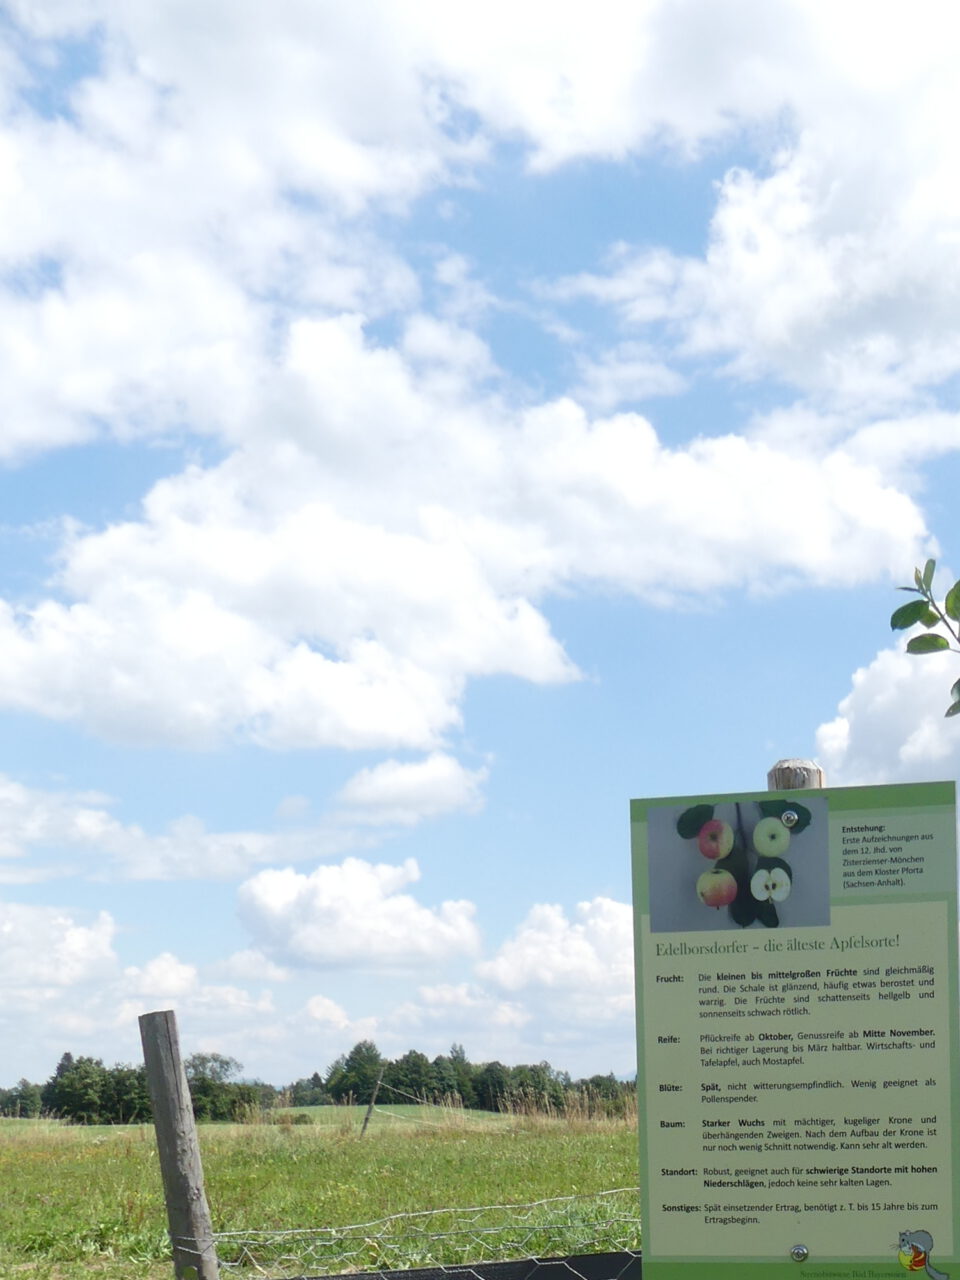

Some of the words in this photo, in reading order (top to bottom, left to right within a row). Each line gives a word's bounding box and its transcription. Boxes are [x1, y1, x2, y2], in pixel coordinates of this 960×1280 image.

[842, 825, 885, 834] Entstehung:
[842, 837, 861, 845] Erste
[862, 835, 919, 844] Aufzeichnungen
[861, 847, 871, 855] 12.
[873, 846, 888, 854] Jhd.
[843, 856, 925, 867] Zisterzienser-Mönchen
[857, 869, 873, 877] dem
[875, 866, 900, 876] Kloster
[901, 866, 923, 874] Pforta
[843, 878, 905, 889] (Sachsen-Anhalt).
[656, 940, 748, 956] Edelborsdorfer
[764, 939, 783, 952] die
[787, 938, 825, 951] älteste
[830, 934, 899, 952] Apfelsorte!
[656, 974, 684, 983] Frucht:
[698, 974, 711, 982] Die
[717, 973, 746, 981] kleinen
[751, 972, 763, 980] bis
[768, 970, 821, 980] mittelgroßen
[826, 968, 858, 977] Früchte
[863, 968, 880, 976] sind
[885, 965, 934, 977] gleichmäßig
[699, 985, 720, 994] rund.
[723, 985, 736, 993] Die
[740, 984, 765, 993] Schale
[769, 984, 778, 992] ist
[782, 982, 820, 993] glänzend,
[824, 981, 849, 991] häufig
[852, 981, 876, 989] etwas
[880, 979, 915, 988] berostet
[918, 977, 934, 986] und
[699, 997, 726, 1007] warzig.
[734, 997, 748, 1005] Die
[756, 995, 786, 1005] Früchte
[794, 994, 810, 1003] sind
[818, 993, 870, 1002] schattenseits
[878, 991, 911, 1001] hellgelb
[918, 990, 934, 999] und
[699, 1008, 746, 1018] sonnenseits
[747, 1008, 781, 1017] schwach
[783, 1007, 810, 1016] rötlich.
[658, 1035, 680, 1044] Reife:
[700, 1034, 741, 1042] Pflückreife
[758, 1033, 794, 1042] Oktober,
[798, 1031, 844, 1040] Genussreife
[848, 1030, 859, 1038] ab
[863, 1030, 886, 1038] Mitte
[890, 1028, 936, 1037] November.
[700, 1047, 712, 1055] Bei
[716, 1046, 748, 1056] richtiger
[752, 1046, 789, 1055] Lagerung
[792, 1044, 804, 1053] bis
[808, 1044, 828, 1052] März
[832, 1043, 862, 1051] haltbar.
[866, 1040, 916, 1050] Wirtschafts-
[920, 1040, 936, 1049] und
[700, 1058, 740, 1068] Tafelapfel,
[742, 1057, 761, 1066] auch
[762, 1056, 804, 1066] Mostapfel.
[659, 1084, 682, 1092] Blüte:
[701, 1083, 722, 1093] Spät,
[728, 1082, 747, 1091] nicht
[753, 1080, 844, 1091] witterungsempfindlich.
[851, 1080, 877, 1089] Wenig
[883, 1079, 918, 1089] geeignet
[925, 1078, 936, 1086] als
[702, 1094, 758, 1104] Pollenspender.
[702, 1119, 731, 1127] Starker
[738, 1119, 765, 1127] Wuchs
[794, 1118, 836, 1127] mächtiger,
[844, 1117, 880, 1127] kugeliger
[921, 1115, 936, 1124] und
[702, 1131, 764, 1141] überhängenden
[767, 1130, 802, 1140] Zweigen.
[806, 1130, 826, 1138] Nach
[829, 1129, 847, 1138] dem
[850, 1129, 879, 1137] Aufbau
[882, 1129, 897, 1137] der
[900, 1128, 924, 1136] Krone
[927, 1128, 936, 1136] ist
[718, 1143, 737, 1152] noch
[739, 1143, 763, 1152] wenig
[764, 1142, 792, 1151] Schnitt
[794, 1142, 838, 1152] notwendig.
[840, 1142, 860, 1150] Kann
[862, 1141, 880, 1150] sehr
[882, 1141, 892, 1149] alt
[894, 1141, 928, 1149] werden.
[661, 1168, 698, 1176] Standort:
[704, 1168, 732, 1176] Robust,
[735, 1168, 768, 1177] geeignet
[771, 1167, 790, 1175] auch
[792, 1167, 804, 1175] für
[806, 1166, 849, 1176] schwierige
[851, 1166, 892, 1174] Standorte
[894, 1166, 909, 1174] mit
[911, 1165, 938, 1173] hohen
[704, 1179, 766, 1189] Niederschlägen,
[768, 1179, 795, 1189] jedoch
[797, 1179, 818, 1187] keine
[820, 1179, 838, 1187] sehr
[840, 1178, 864, 1186] kalten
[866, 1178, 892, 1188] Lagen.
[662, 1204, 702, 1213] Sonstiges:
[704, 1204, 721, 1213] Spät
[723, 1203, 774, 1212] einsetzender
[776, 1204, 802, 1213] Ertrag,
[804, 1203, 837, 1213] benötigt
[857, 1203, 868, 1211] bis
[872, 1203, 881, 1211] 15
[883, 1203, 905, 1211] Jahre
[907, 1202, 919, 1211] bis
[705, 1216, 760, 1225] Ertragsbeginn.
